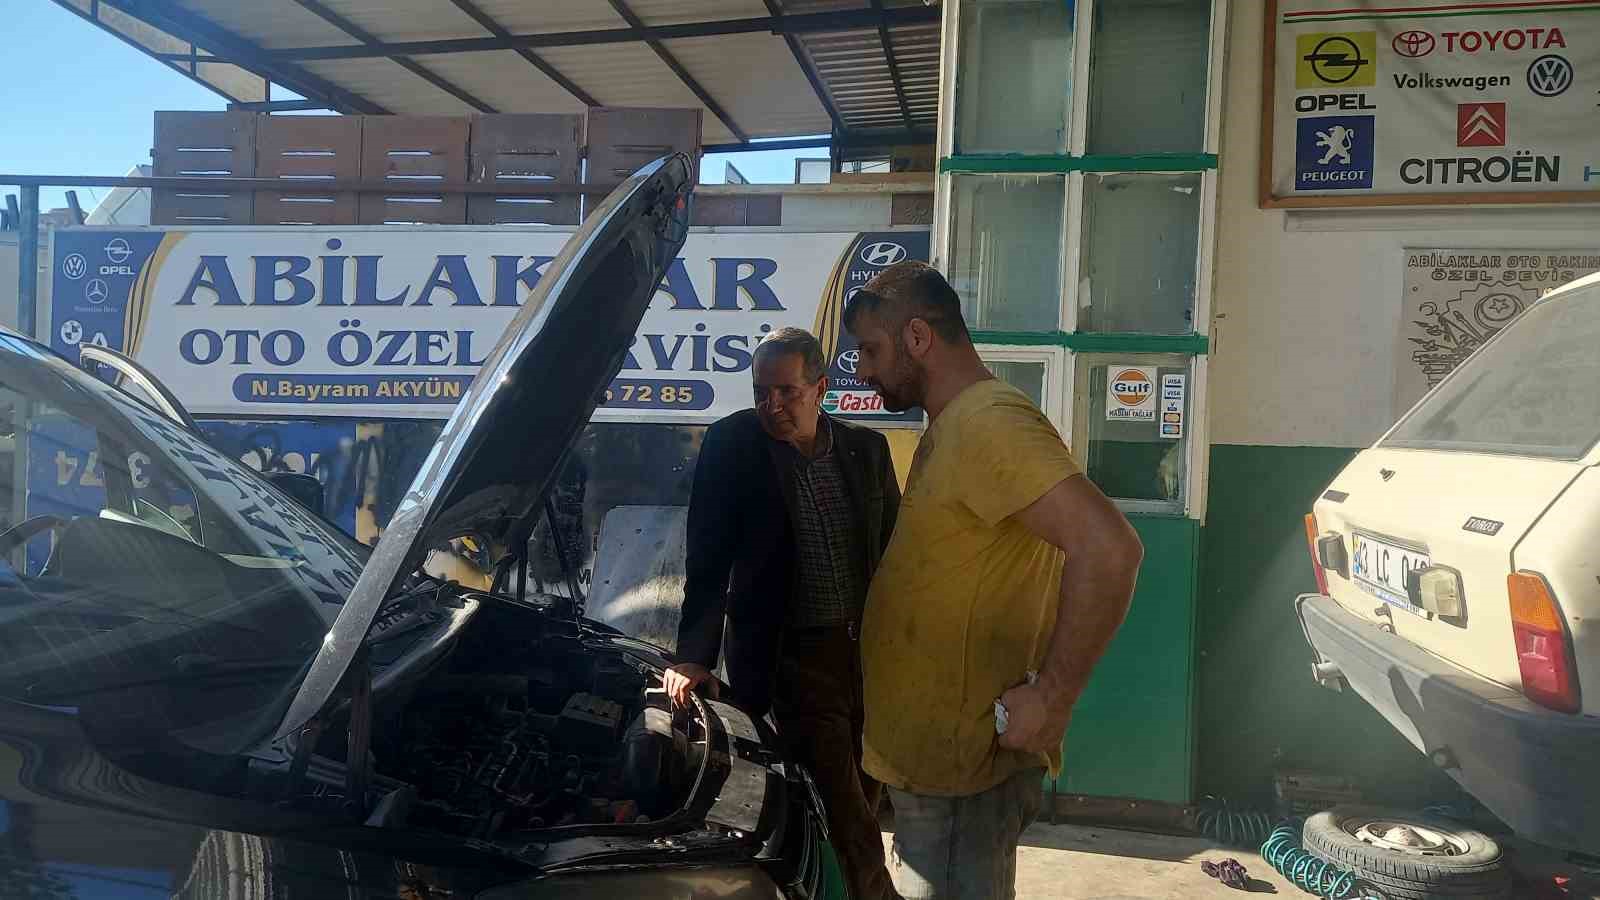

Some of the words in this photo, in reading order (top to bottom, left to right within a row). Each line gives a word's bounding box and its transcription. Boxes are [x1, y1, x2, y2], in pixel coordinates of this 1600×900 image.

[1442, 28, 1567, 52] TOYOTA
[1393, 73, 1511, 91] Volkswagen
[1295, 94, 1377, 113] OPEL
[1302, 170, 1367, 182] PEUGEOT
[1399, 150, 1560, 185] CITROËN
[1407, 252, 1501, 268] ABİLAKLAR
[1506, 256, 1541, 268] OTO
[100, 265, 136, 275] OPEL
[175, 238, 787, 312] ABİLAKAR
[1431, 268, 1494, 281] ÖZEL
[179, 329, 306, 366] OTO
[326, 318, 487, 366] ÖZEL
[251, 380, 369, 401] N.Bayram
[375, 380, 461, 398] AKYÜN
[620, 385, 652, 402] 72
[660, 386, 693, 403] 85
[1114, 382, 1150, 392] Gulf
[1375, 544, 1390, 583] LC
